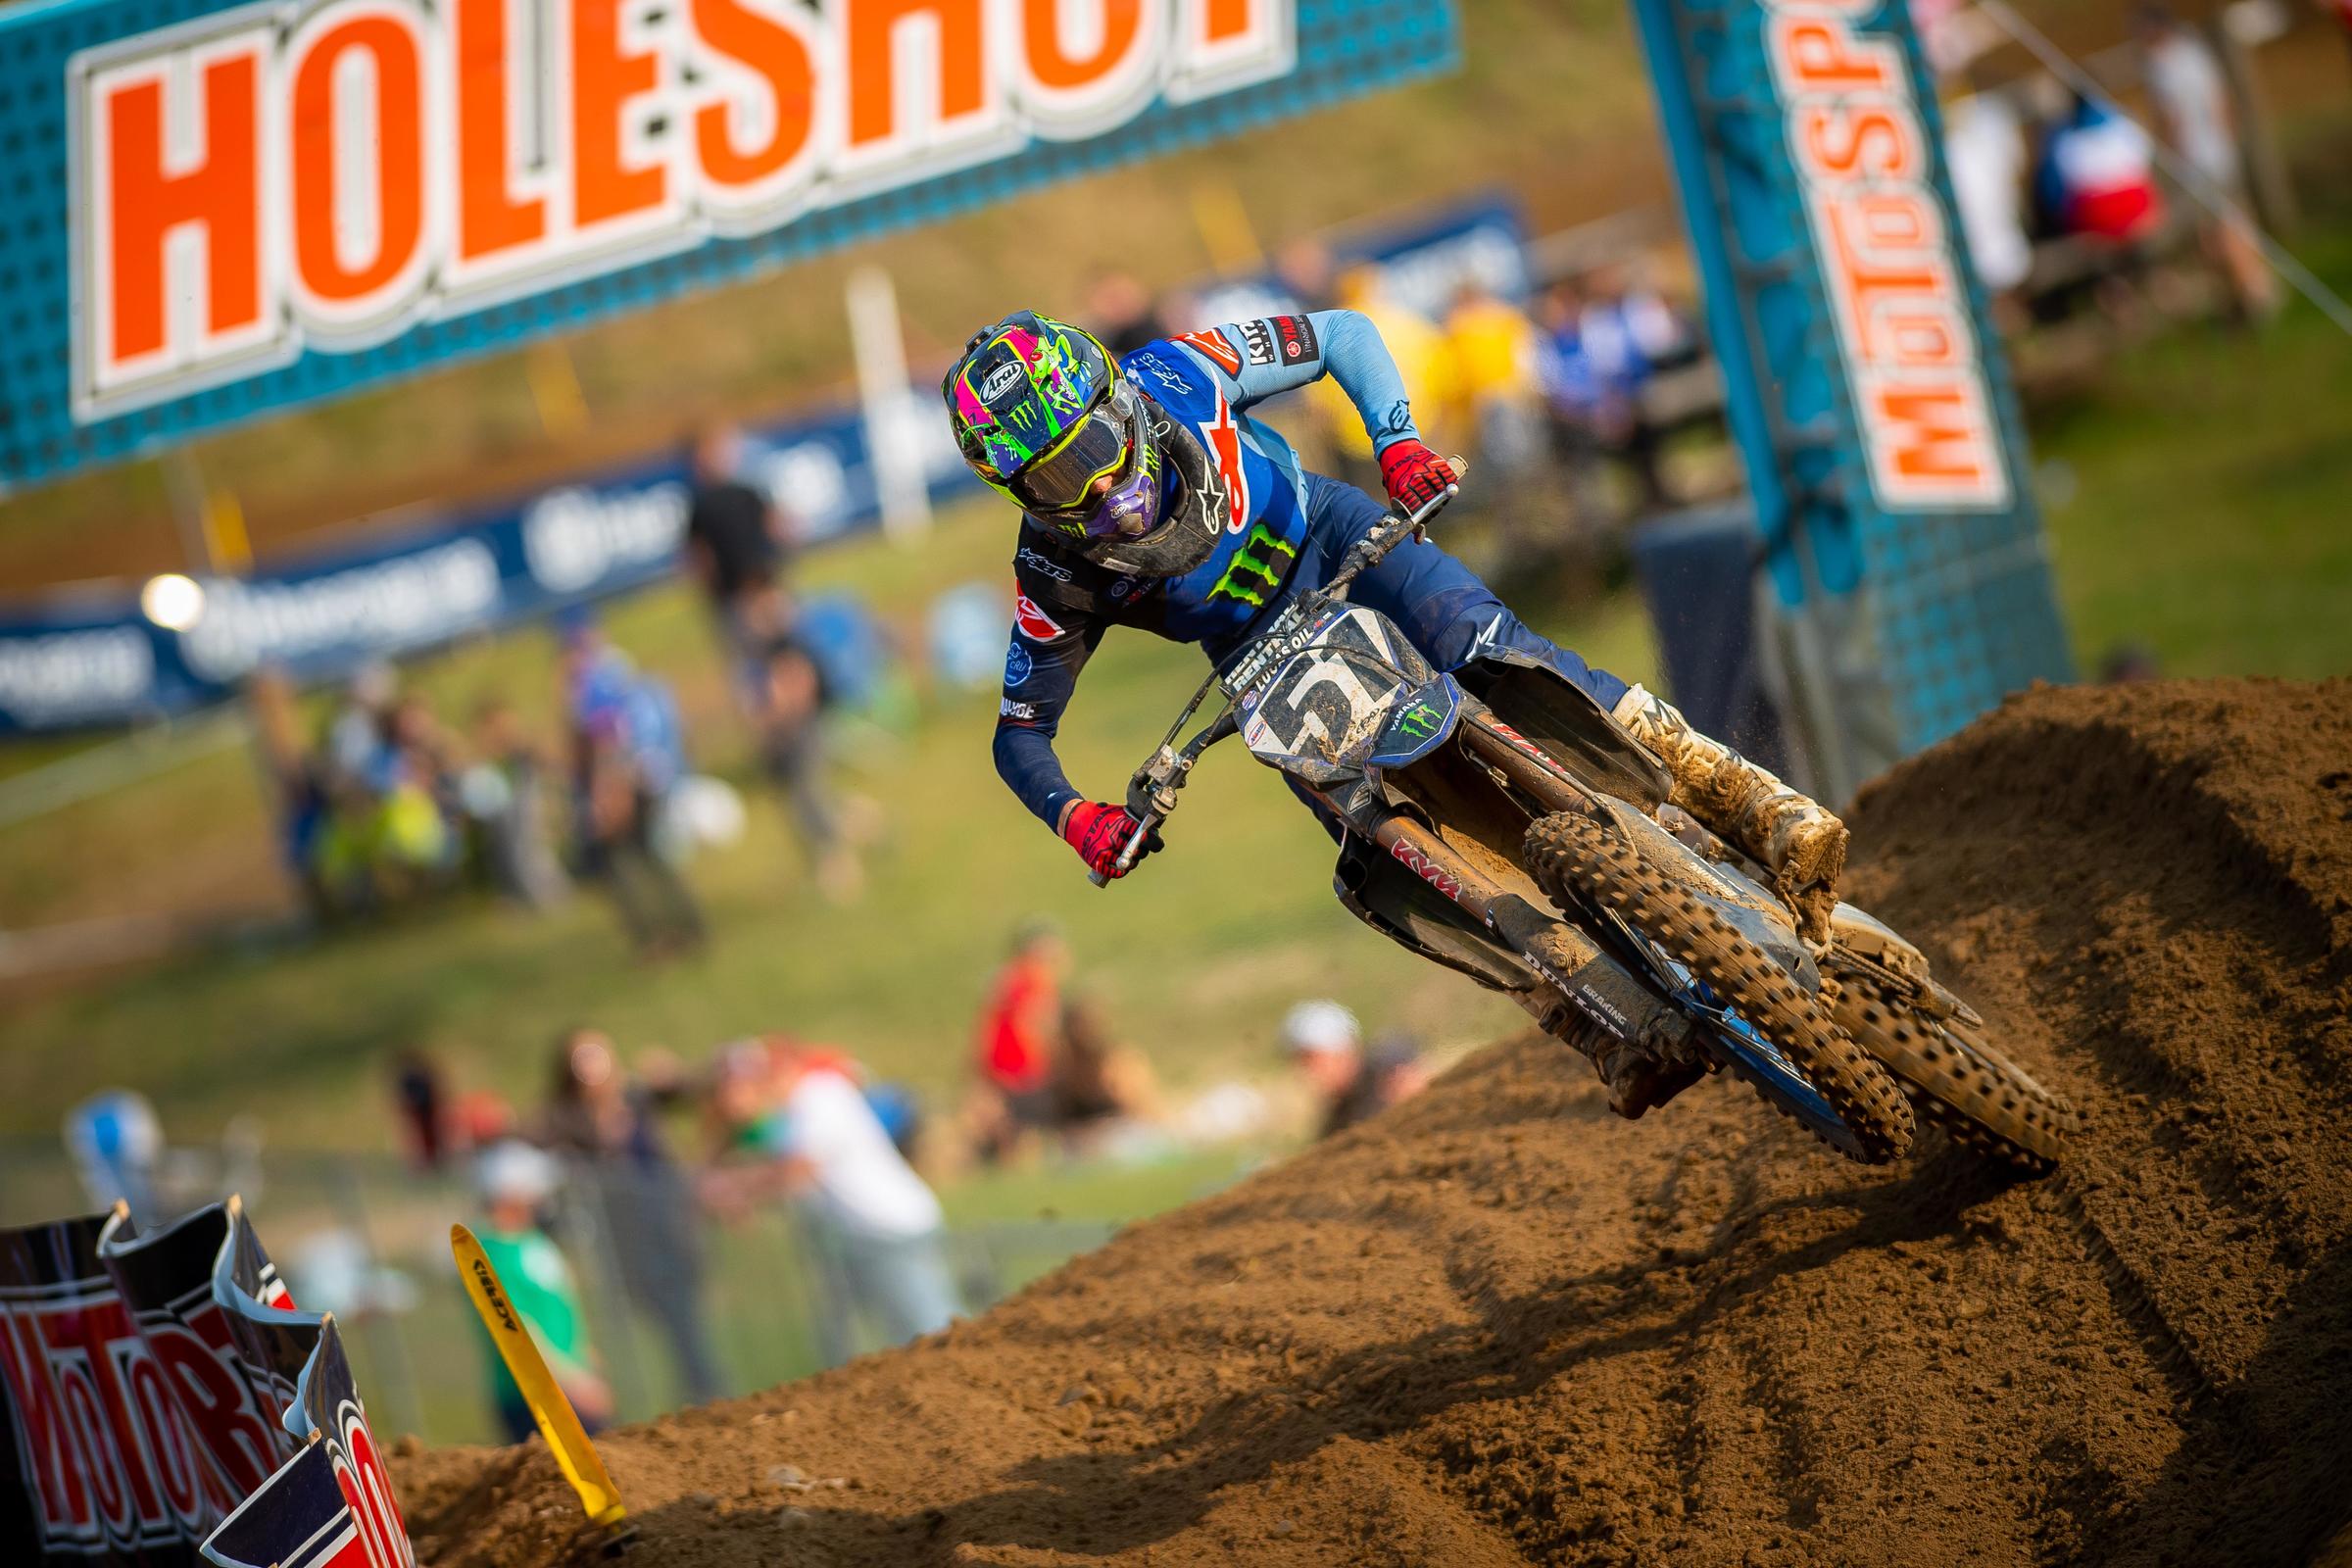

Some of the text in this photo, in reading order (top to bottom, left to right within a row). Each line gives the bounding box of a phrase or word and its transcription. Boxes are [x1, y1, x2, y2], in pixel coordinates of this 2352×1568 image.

[106, 0, 1250, 367] HOLESH
[1780, 0, 1983, 487] MOTOSP
[982, 363, 1019, 402] Arai
[1291, 627, 1315, 649] OIL
[1390, 697, 1423, 732] YAMAHA
[1522, 951, 1625, 1039] DUNLOP
[1581, 983, 1628, 1027] BRAKING
